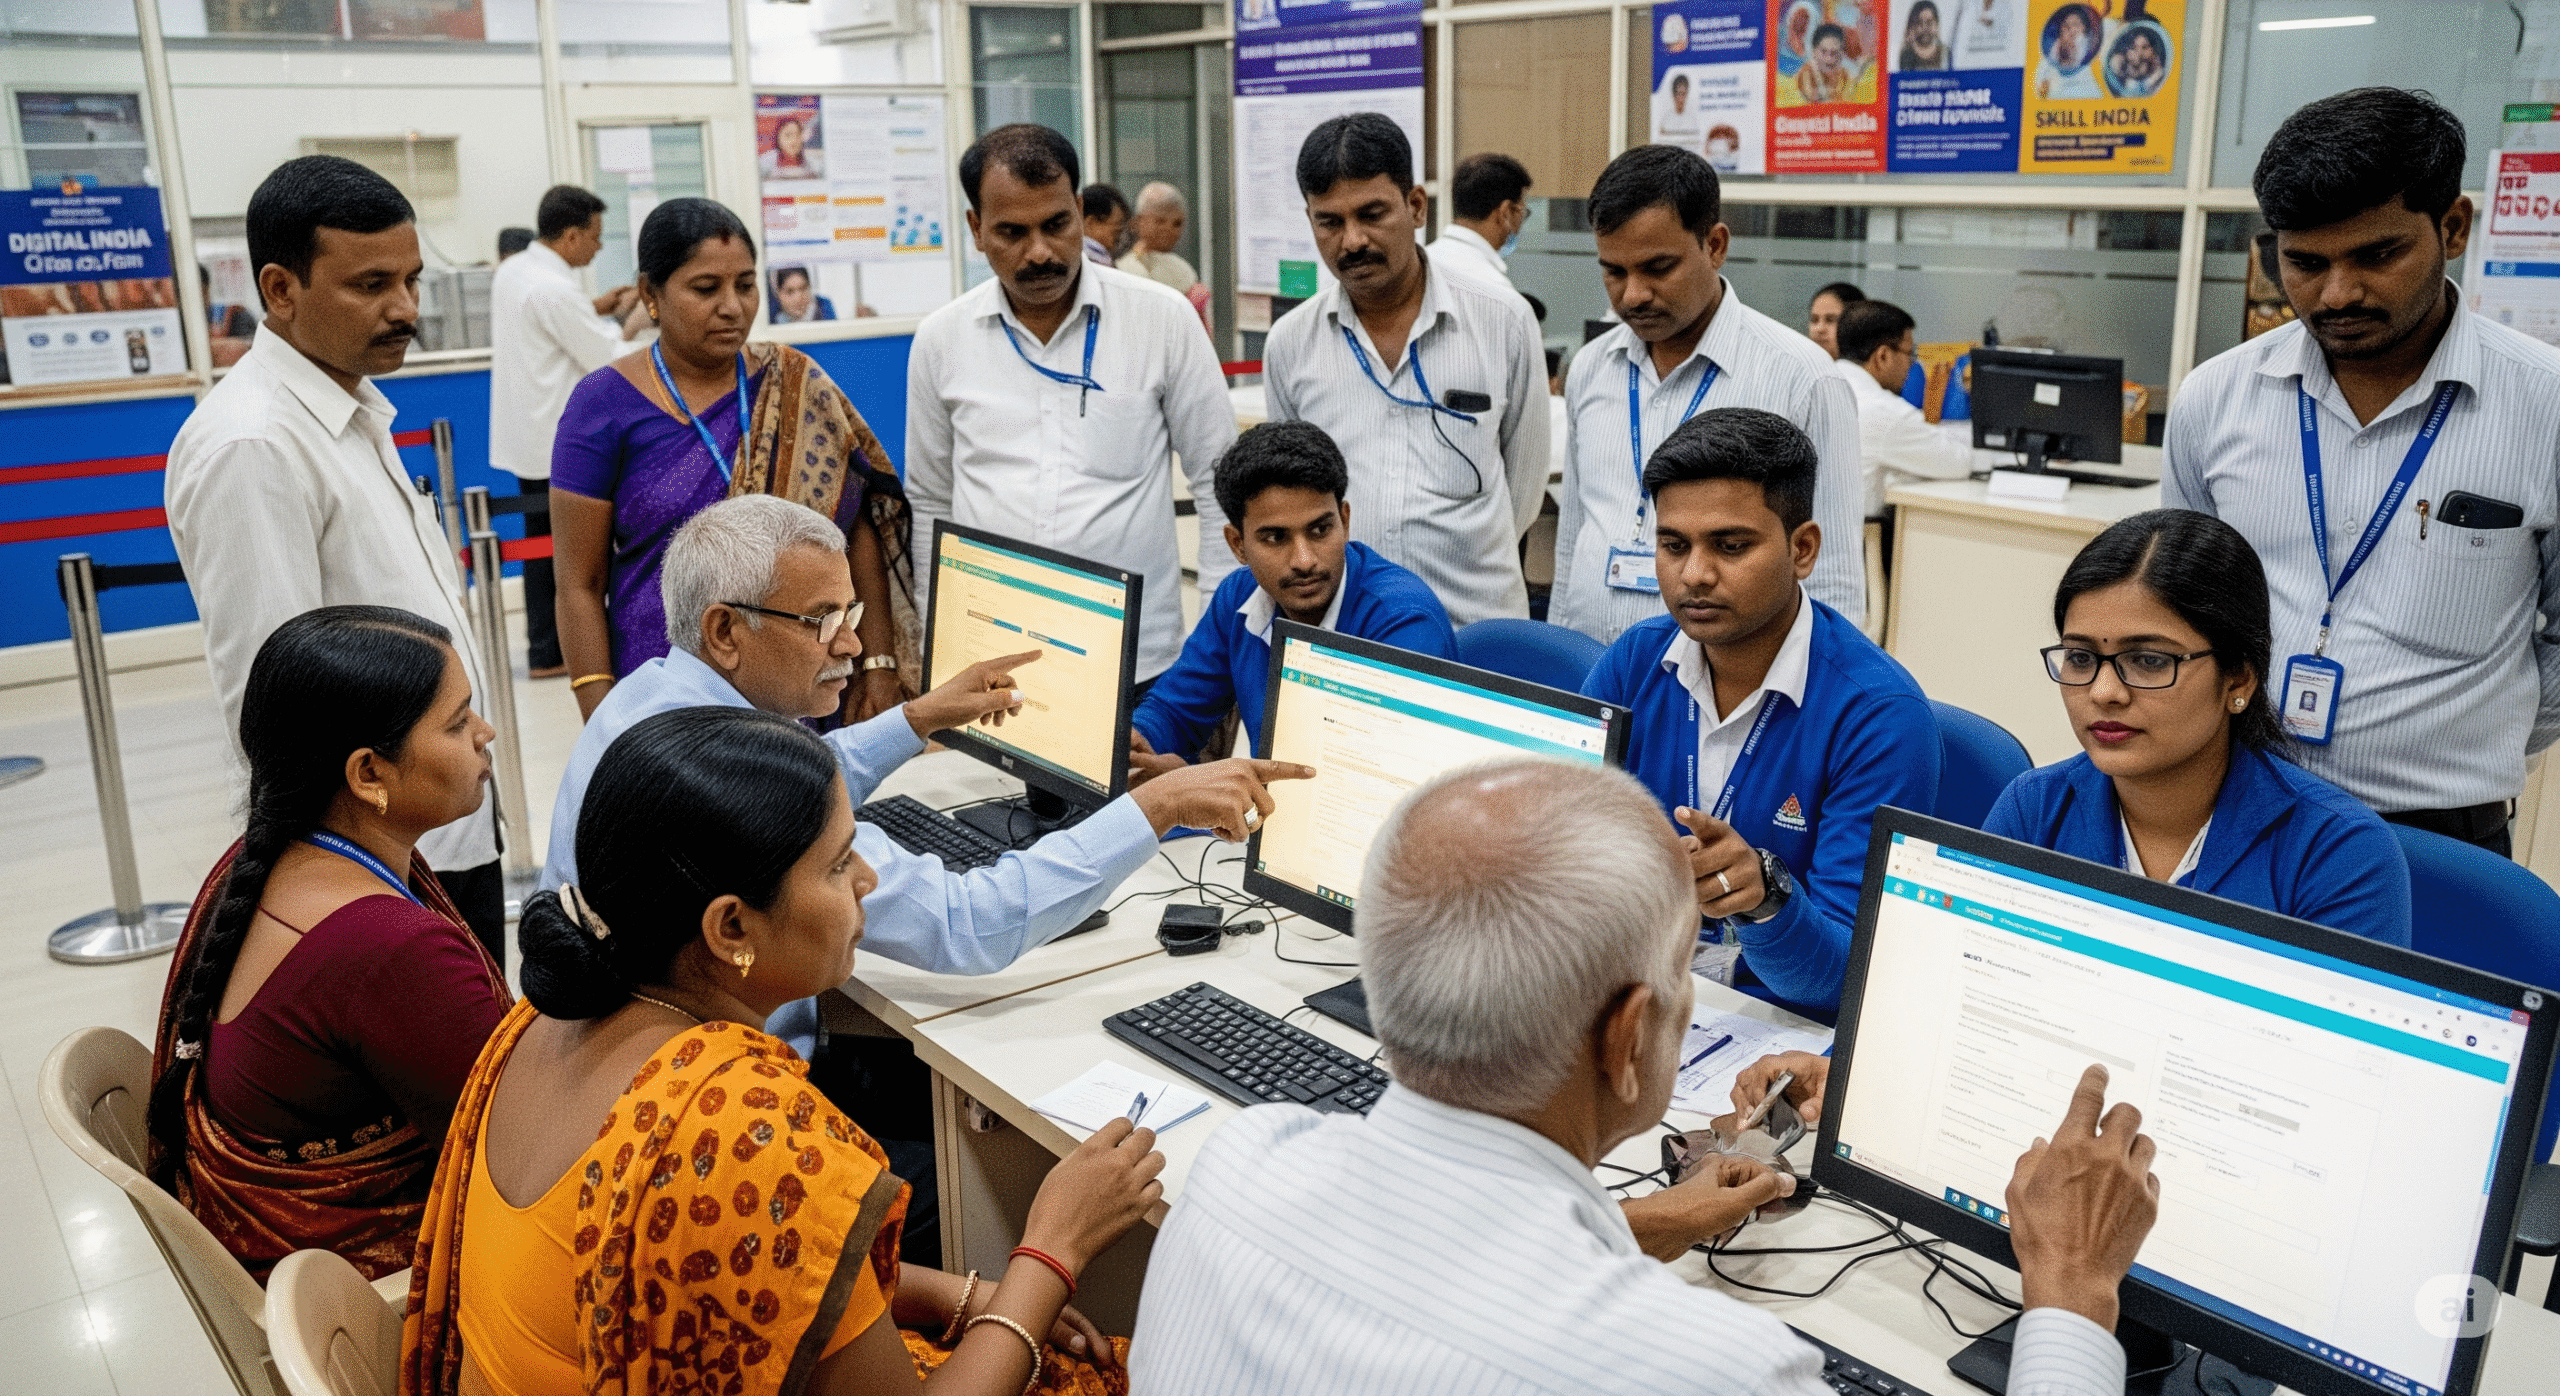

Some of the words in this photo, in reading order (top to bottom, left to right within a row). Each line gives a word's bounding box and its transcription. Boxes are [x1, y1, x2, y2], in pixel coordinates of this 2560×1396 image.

[2036, 110, 2088, 128] SKILL
[2093, 108, 2151, 127] INDIA
[8, 230, 90, 253] DIGITAL
[90, 228, 152, 250] INDIA
